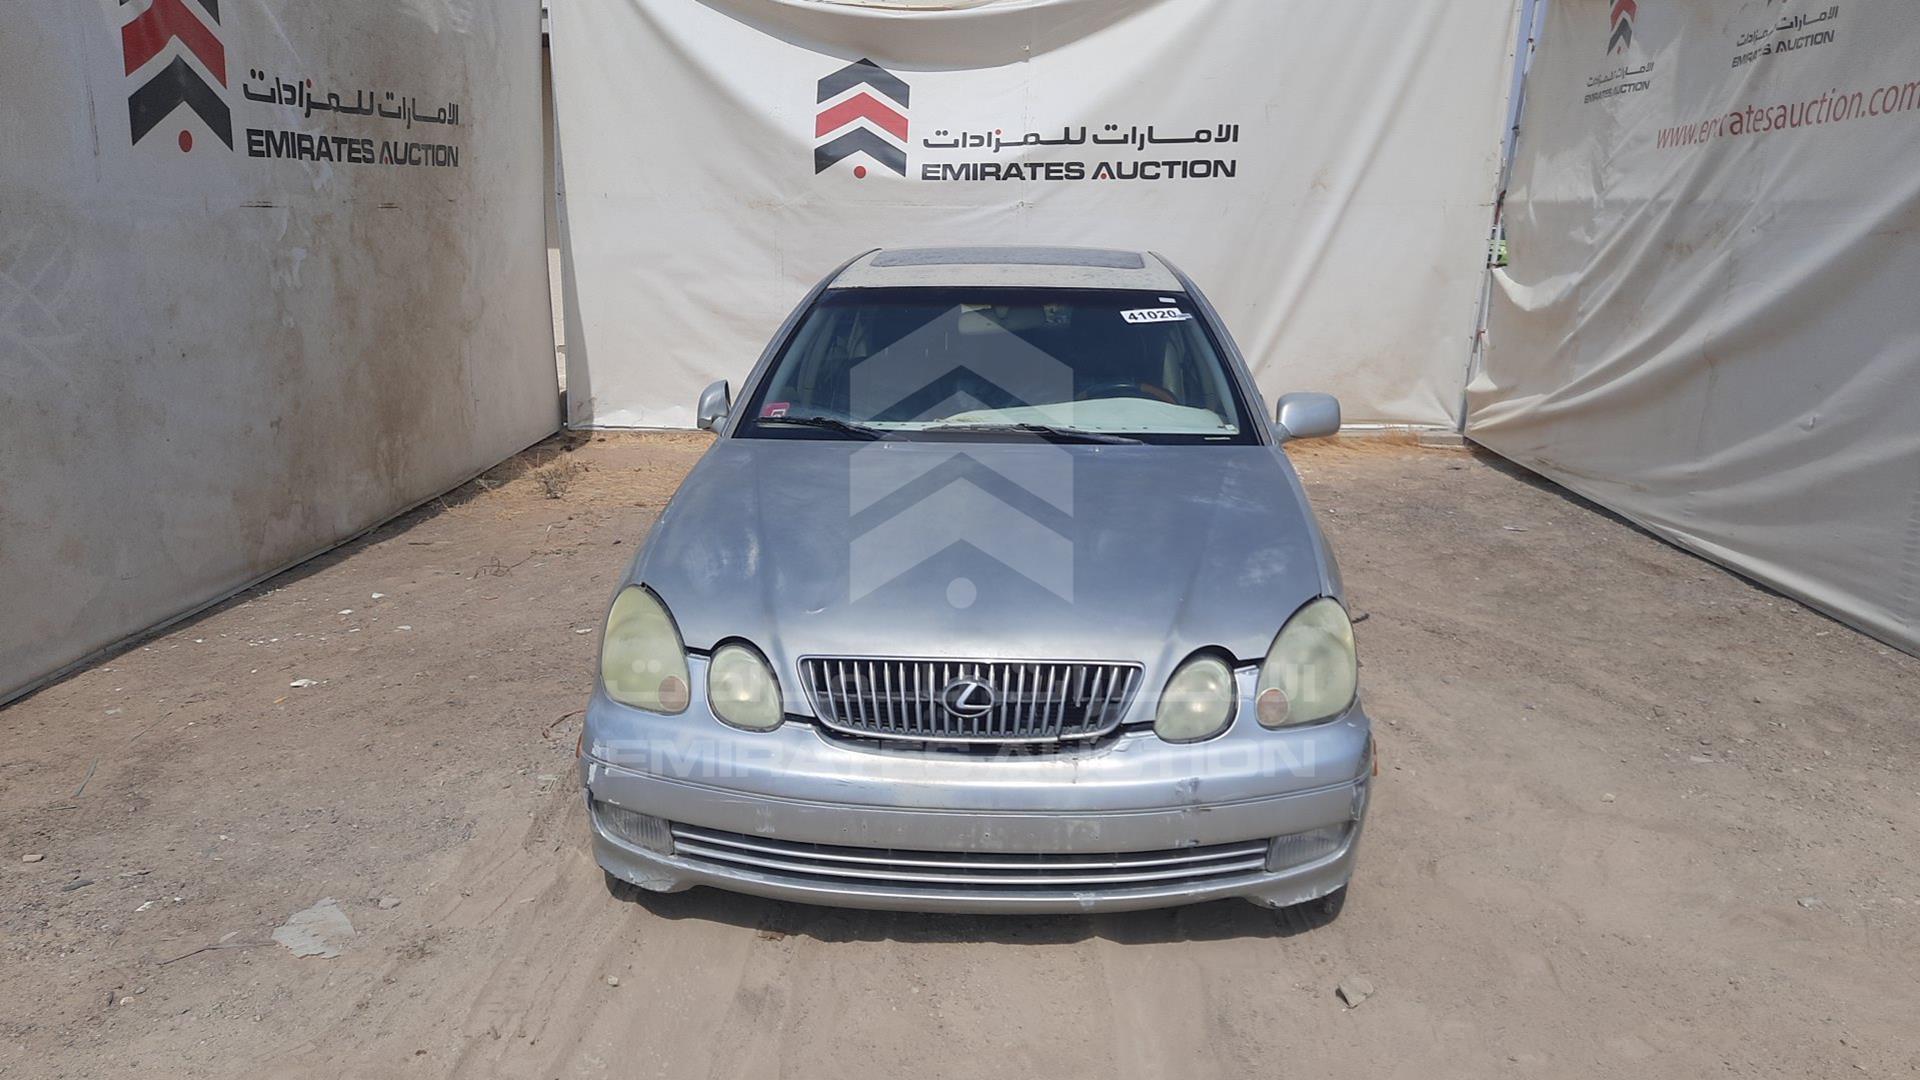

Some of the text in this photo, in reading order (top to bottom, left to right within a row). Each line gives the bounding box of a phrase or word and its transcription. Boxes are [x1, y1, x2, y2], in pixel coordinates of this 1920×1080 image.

[1775, 30, 1835, 53] AUCTION
[378, 92, 459, 129] الامارات
[246, 128, 459, 167] EMIRATES AUCTION
[922, 124, 1239, 153] الامارات للمزادات
[920, 159, 1237, 181] EMIRATES AUCTION
[1127, 309, 1177, 321] 41020
